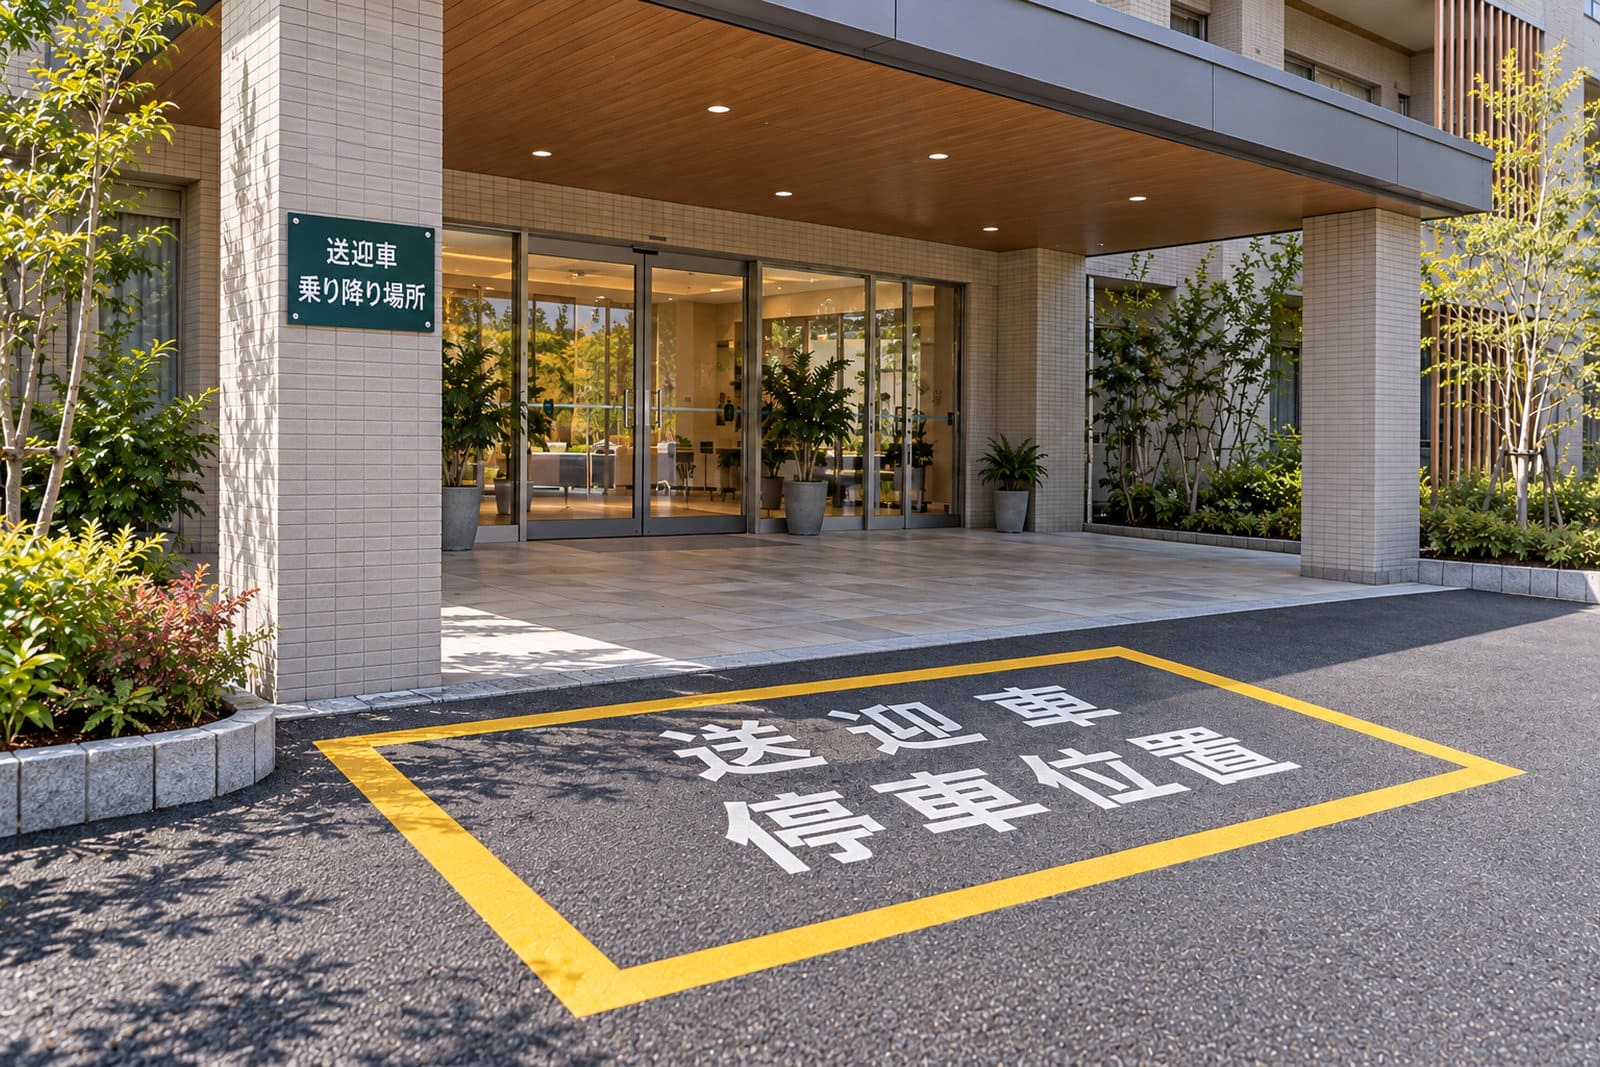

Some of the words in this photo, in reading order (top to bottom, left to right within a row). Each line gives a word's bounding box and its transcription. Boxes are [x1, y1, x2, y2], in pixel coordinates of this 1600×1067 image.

[326, 237, 397, 269] 送迎車
[298, 275, 425, 311] 乗り降り場所
[659, 685, 1122, 782] 送迎車
[724, 726, 1302, 874] 停車位置
